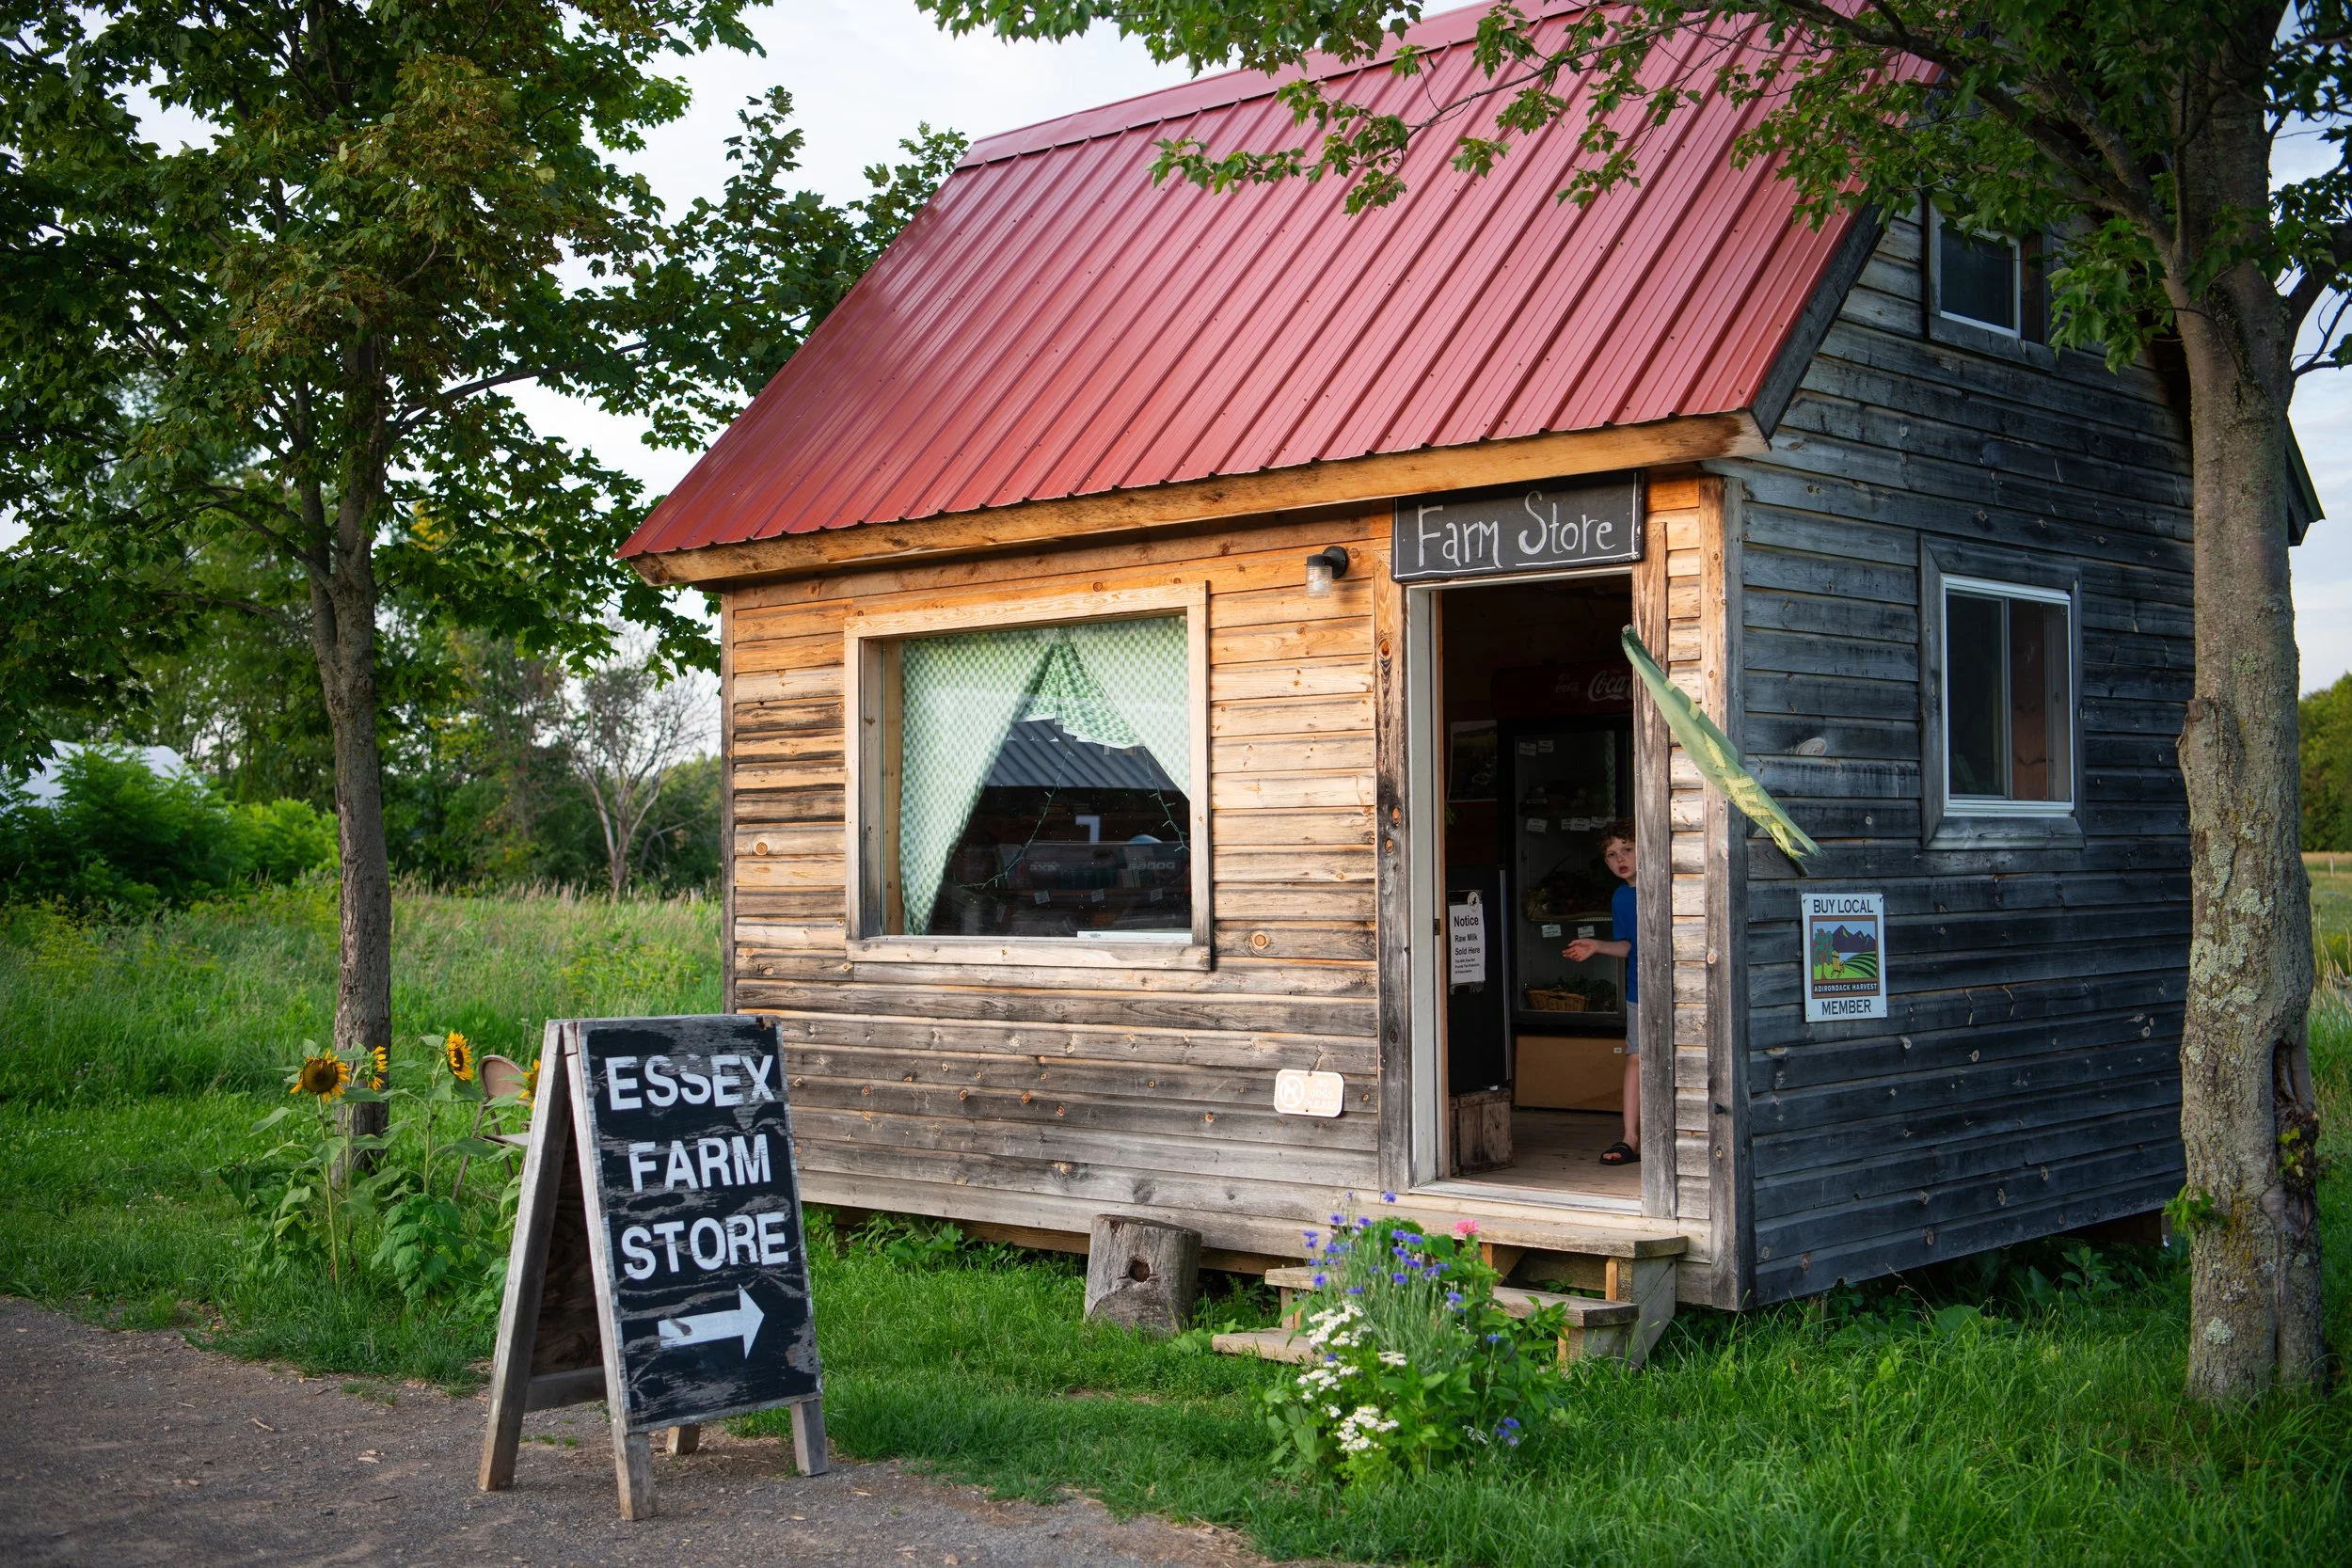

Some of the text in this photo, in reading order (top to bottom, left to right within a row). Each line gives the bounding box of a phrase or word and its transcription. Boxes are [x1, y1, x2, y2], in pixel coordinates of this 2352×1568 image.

[1418, 490, 1616, 569] Farm Store
[1813, 898, 1874, 913] BUY LOCAL
[1454, 915, 1479, 927] Notice
[1454, 933, 1478, 942] Raw Milk
[1454, 945, 1481, 956] Sold Here
[1814, 984, 1851, 992] ADIRONDACK
[1821, 999, 1872, 1016] MEMBER
[605, 1053, 776, 1111] ESSEX
[628, 1133, 771, 1193] FARM
[621, 1211, 789, 1279] STORE
